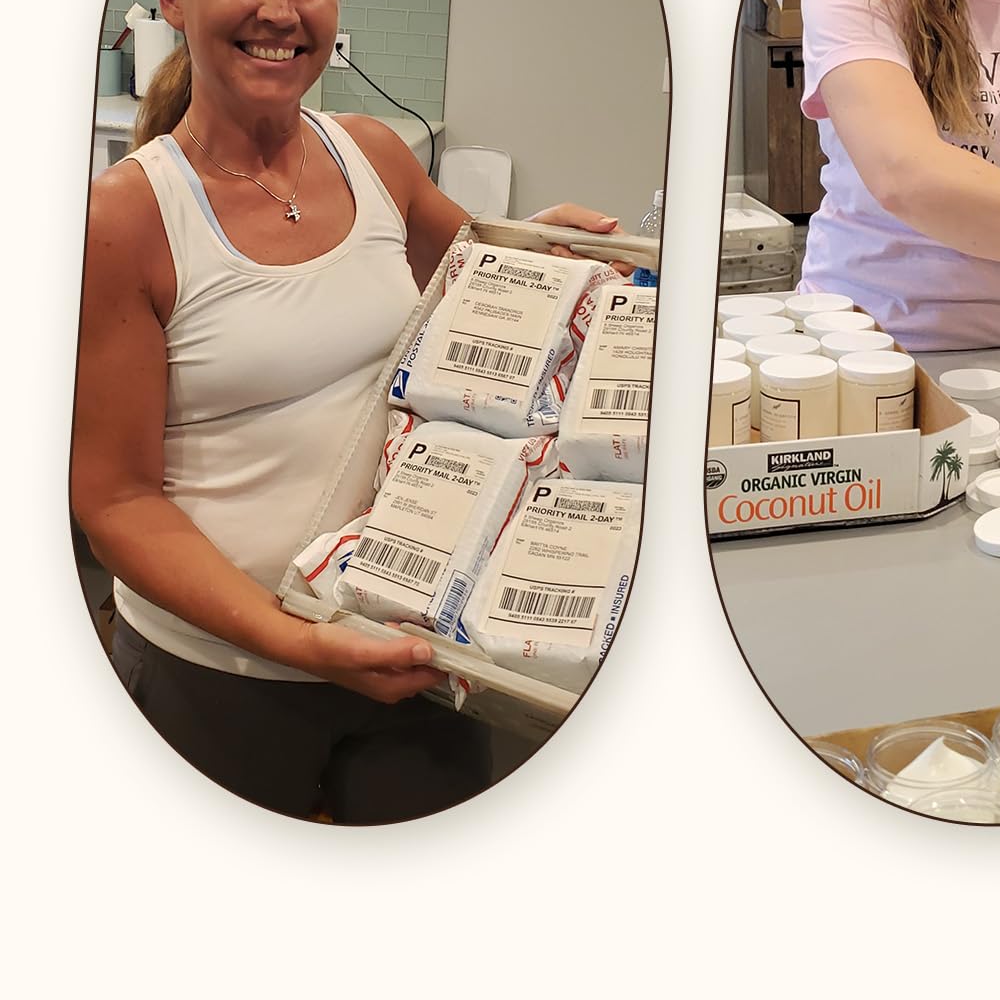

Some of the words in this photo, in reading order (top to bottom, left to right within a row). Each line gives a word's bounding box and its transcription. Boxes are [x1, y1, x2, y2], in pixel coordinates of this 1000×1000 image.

[479, 254, 497, 268] P
[473, 270, 508, 283] PRIORITY
[509, 277, 528, 288] MAIL
[610, 295, 628, 311] P
[605, 315, 645, 324] PRIORITY
[408, 443, 427, 459] P
[771, 451, 831, 466] KIRKLAND
[400, 461, 434, 475] PRIORITY
[433, 470, 450, 480] MAIL
[741, 473, 807, 493] ORGANIC
[811, 468, 861, 487] VIRGIN
[532, 486, 552, 502] P
[718, 487, 838, 524] Coconut
[844, 478, 881, 512] Oil
[526, 505, 567, 518] PRIORITY
[567, 512, 588, 521] MAIL
[611, 574, 629, 615] INSURED
[522, 640, 532, 658] FLA
